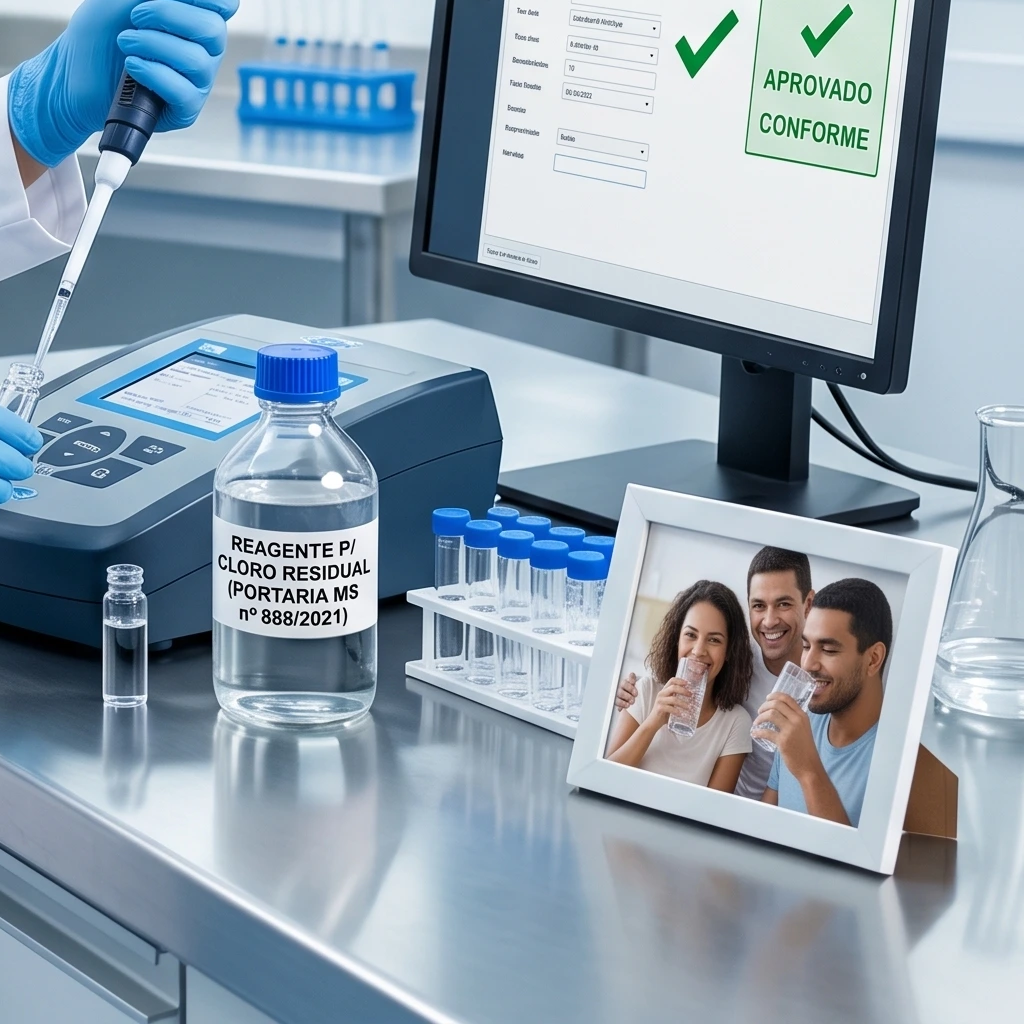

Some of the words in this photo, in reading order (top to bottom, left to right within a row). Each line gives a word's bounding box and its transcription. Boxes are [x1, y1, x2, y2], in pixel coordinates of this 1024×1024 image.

[763, 68, 873, 105] APROVADO
[759, 112, 870, 151] CONFORME
[231, 535, 333, 559] REAGENTE
[339, 538, 356, 556] P/
[218, 554, 277, 580] CLORO
[283, 559, 371, 581] RESIDUAL
[228, 579, 329, 604] (PORTARIA
[333, 584, 359, 602] MS
[239, 607, 257, 621] nº
[261, 607, 348, 627] 888/2021)
